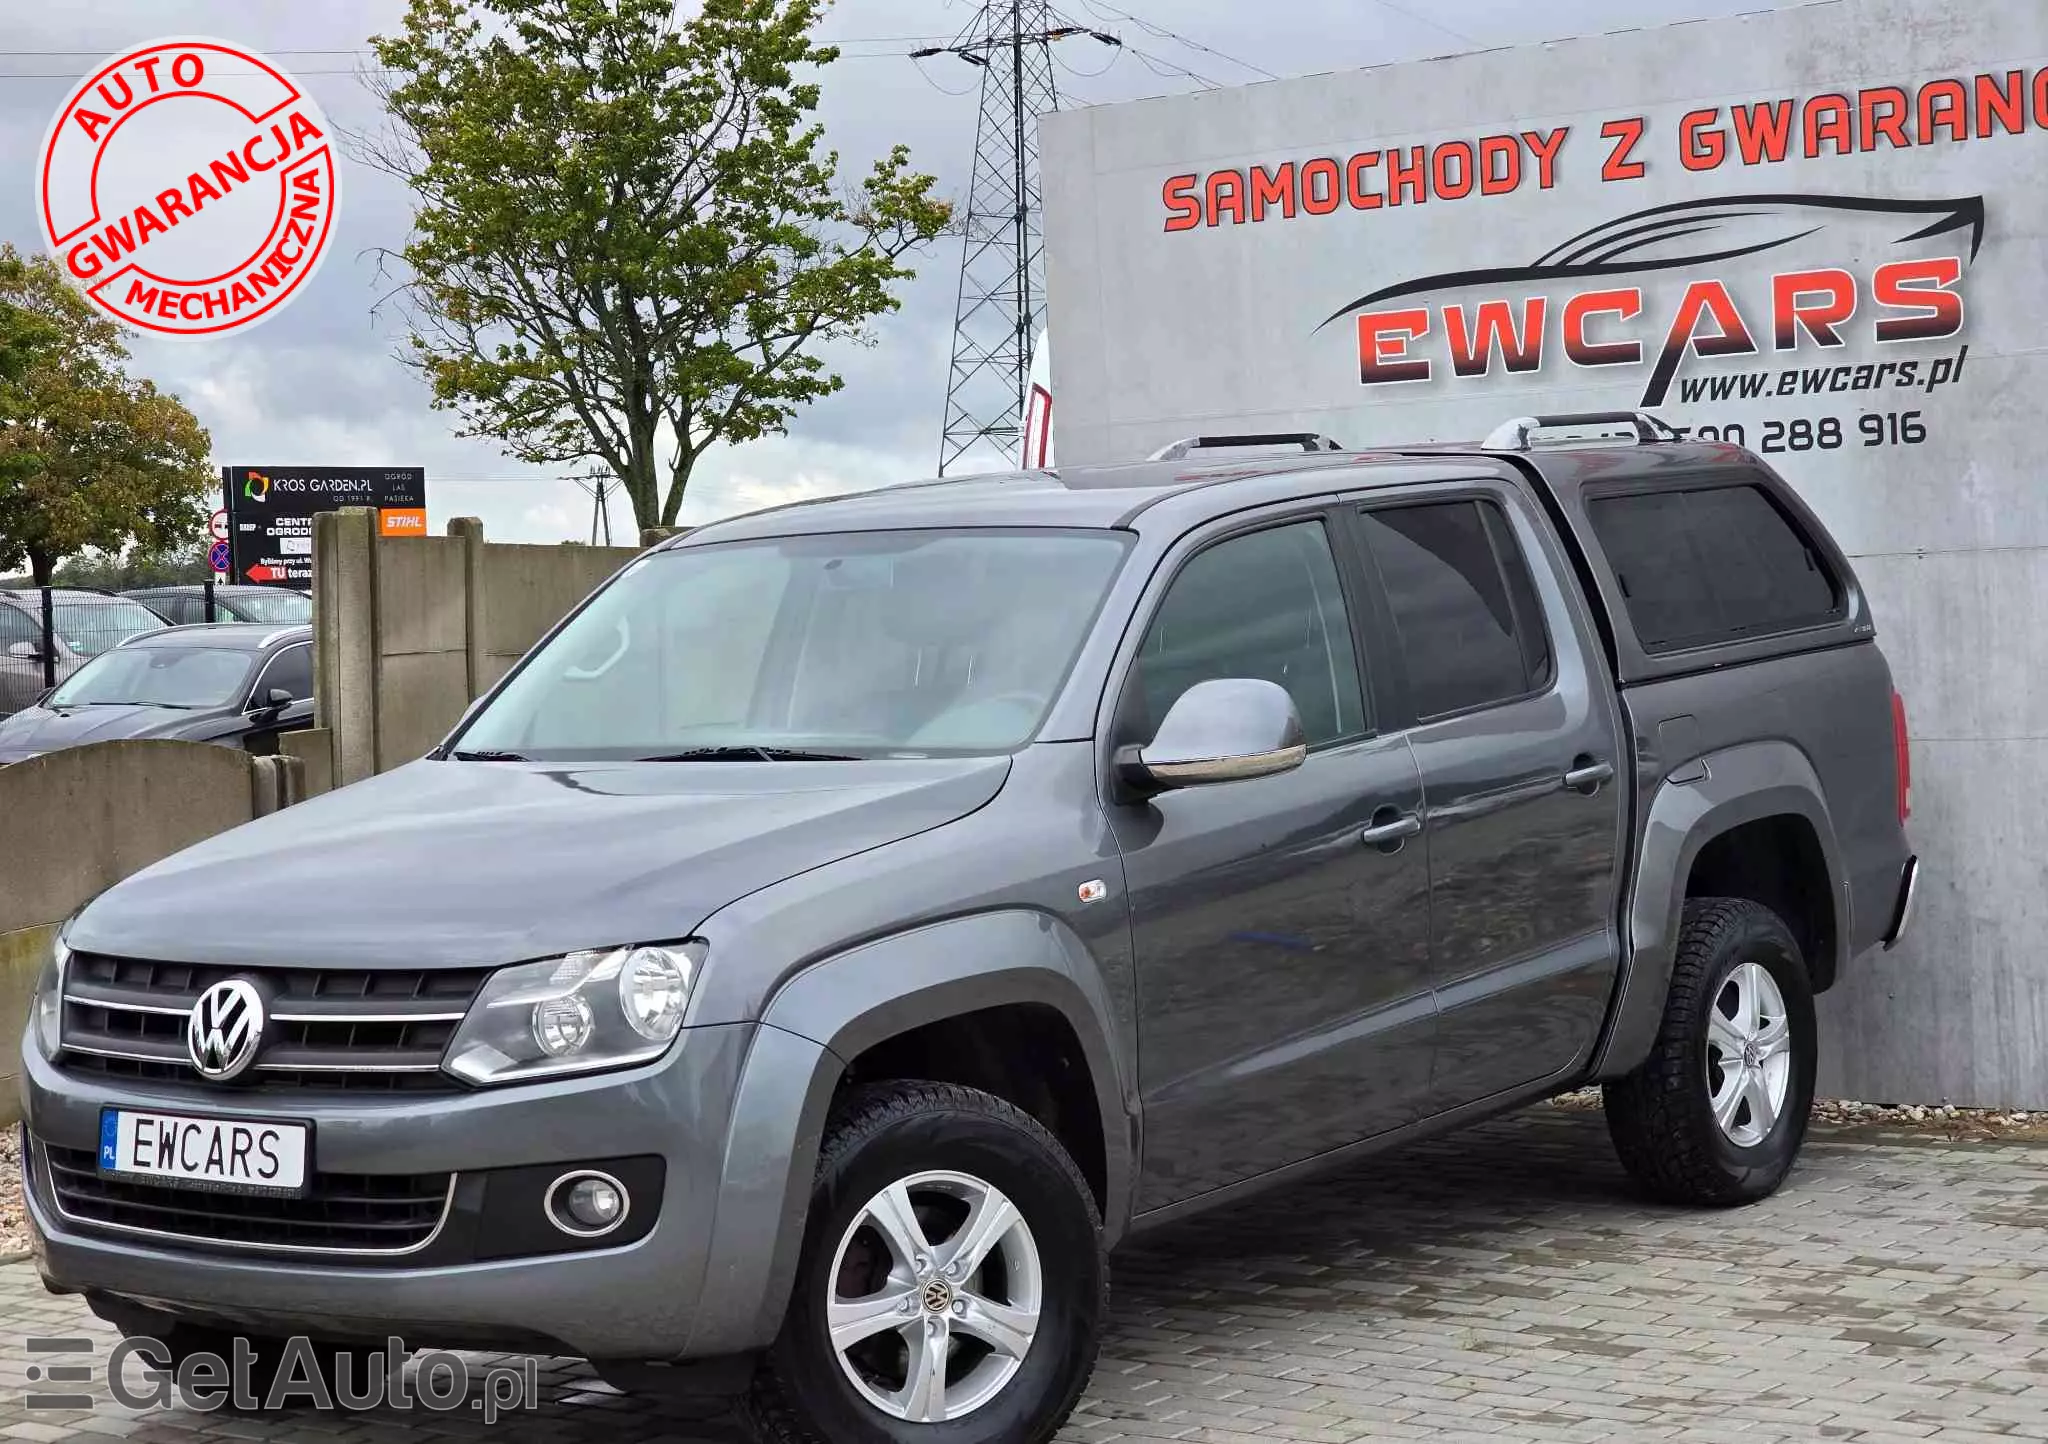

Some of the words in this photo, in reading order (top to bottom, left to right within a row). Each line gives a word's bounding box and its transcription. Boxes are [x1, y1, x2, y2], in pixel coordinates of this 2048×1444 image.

[1162, 126, 1570, 232] SAMOCHODY
[1600, 117, 1645, 182] Z
[1357, 256, 1964, 408] EWCARS
[1680, 344, 1969, 404] www.ewcars.pl
[1762, 417, 1843, 453] 288
[1858, 411, 1926, 447] 916
[273, 479, 306, 492] KROS
[309, 479, 373, 492] GARDEN.PL
[266, 527, 312, 536] OGROD
[386, 515, 422, 528] STIHL
[270, 566, 286, 579] TU
[103, 1145, 116, 1160] PL
[133, 1118, 281, 1179] EWCARS
